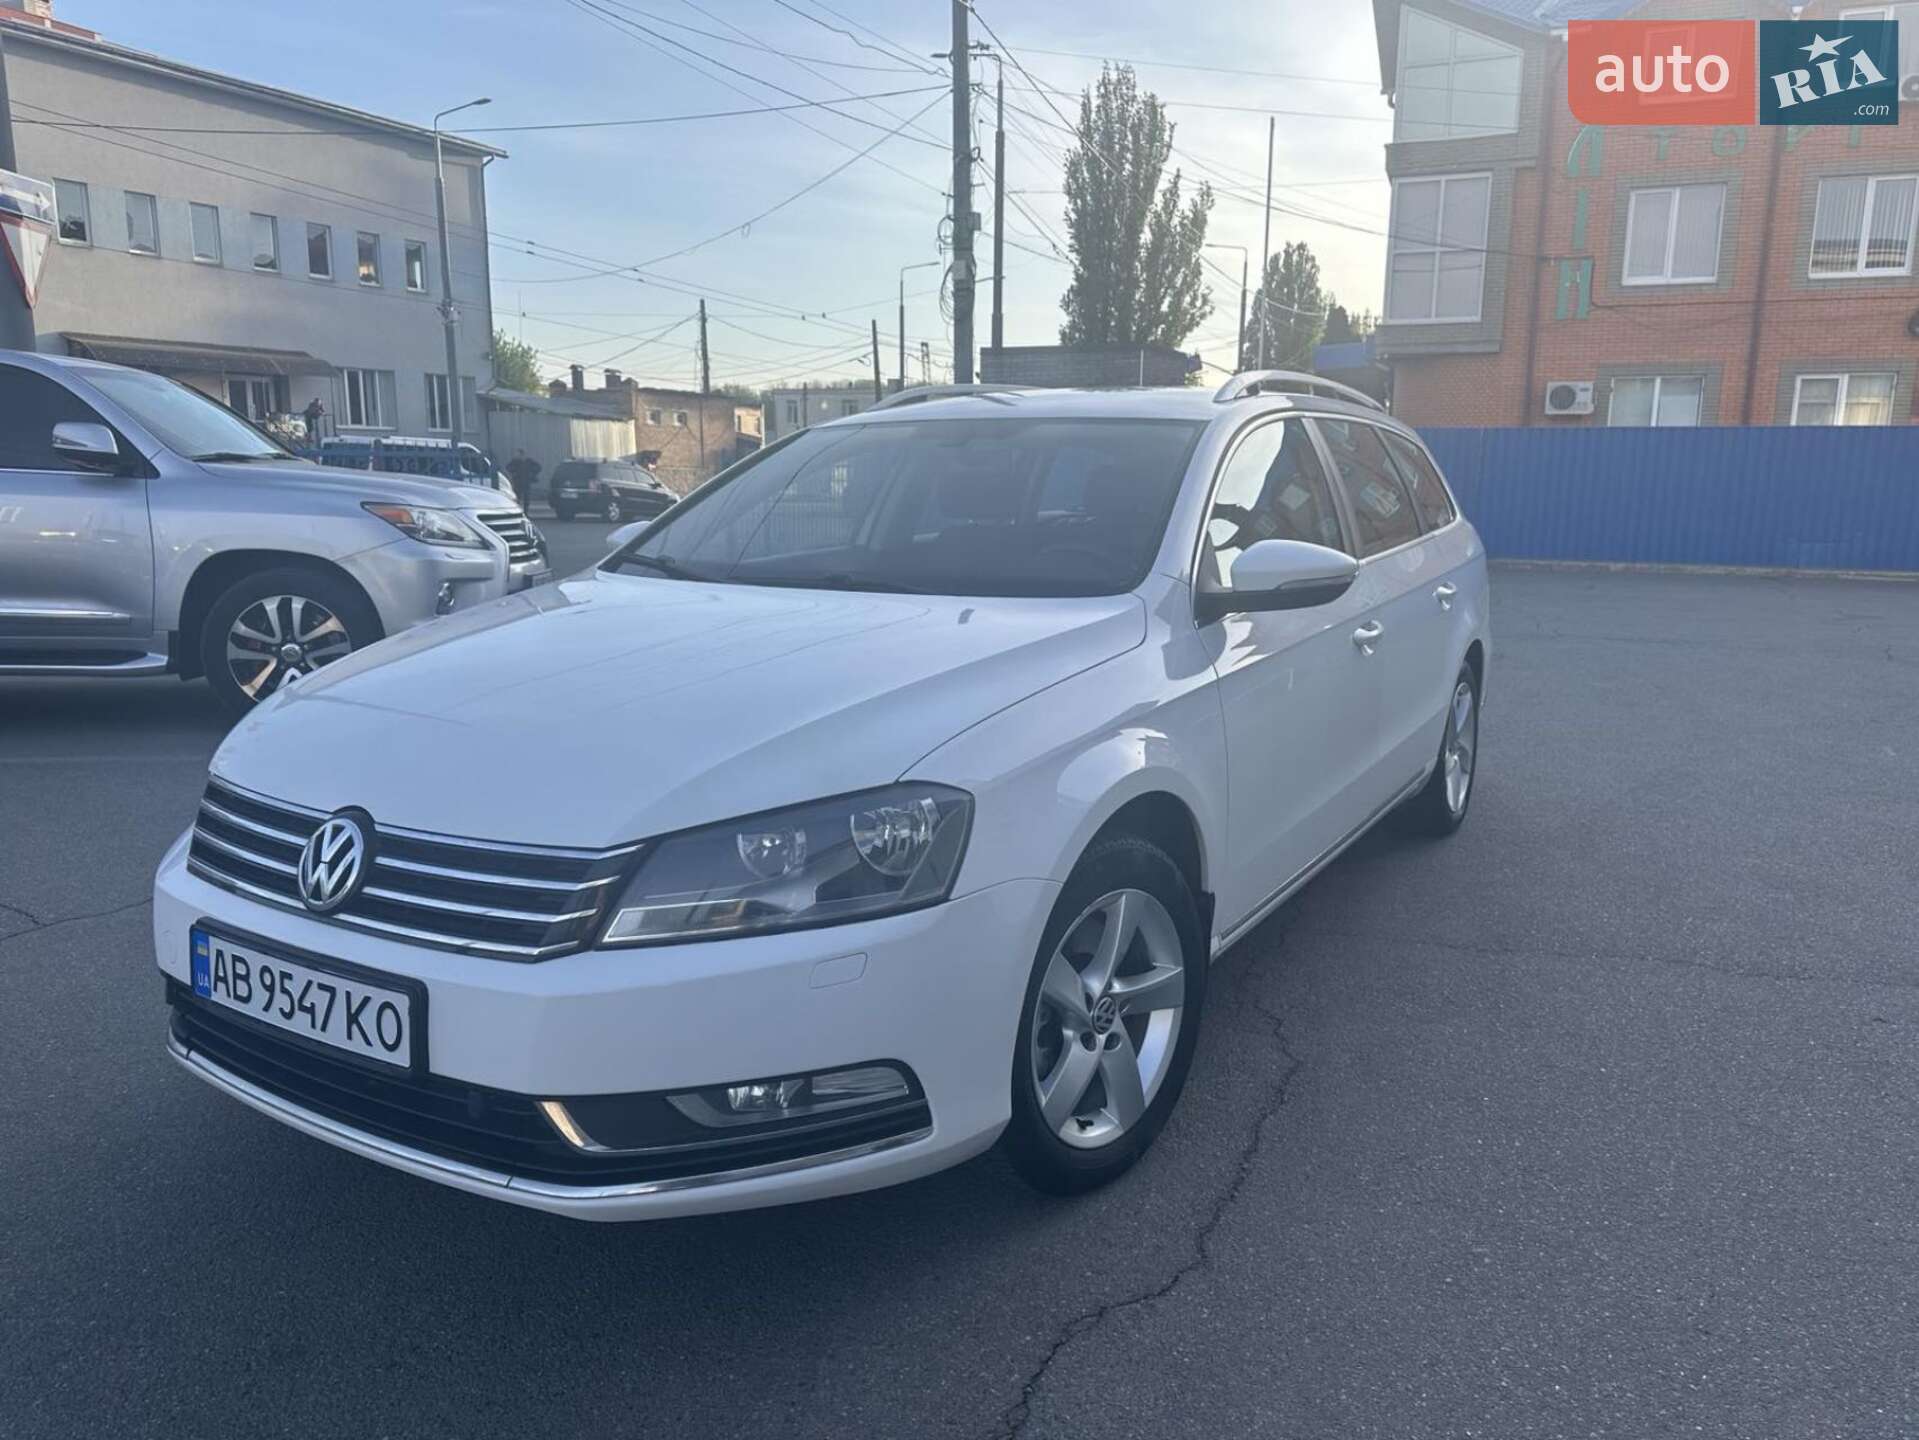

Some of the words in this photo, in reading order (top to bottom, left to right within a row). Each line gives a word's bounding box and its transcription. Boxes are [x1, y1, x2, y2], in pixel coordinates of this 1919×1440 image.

[213, 948, 253, 1005] AB
[259, 964, 337, 1033] 9547
[345, 990, 403, 1053] KO
